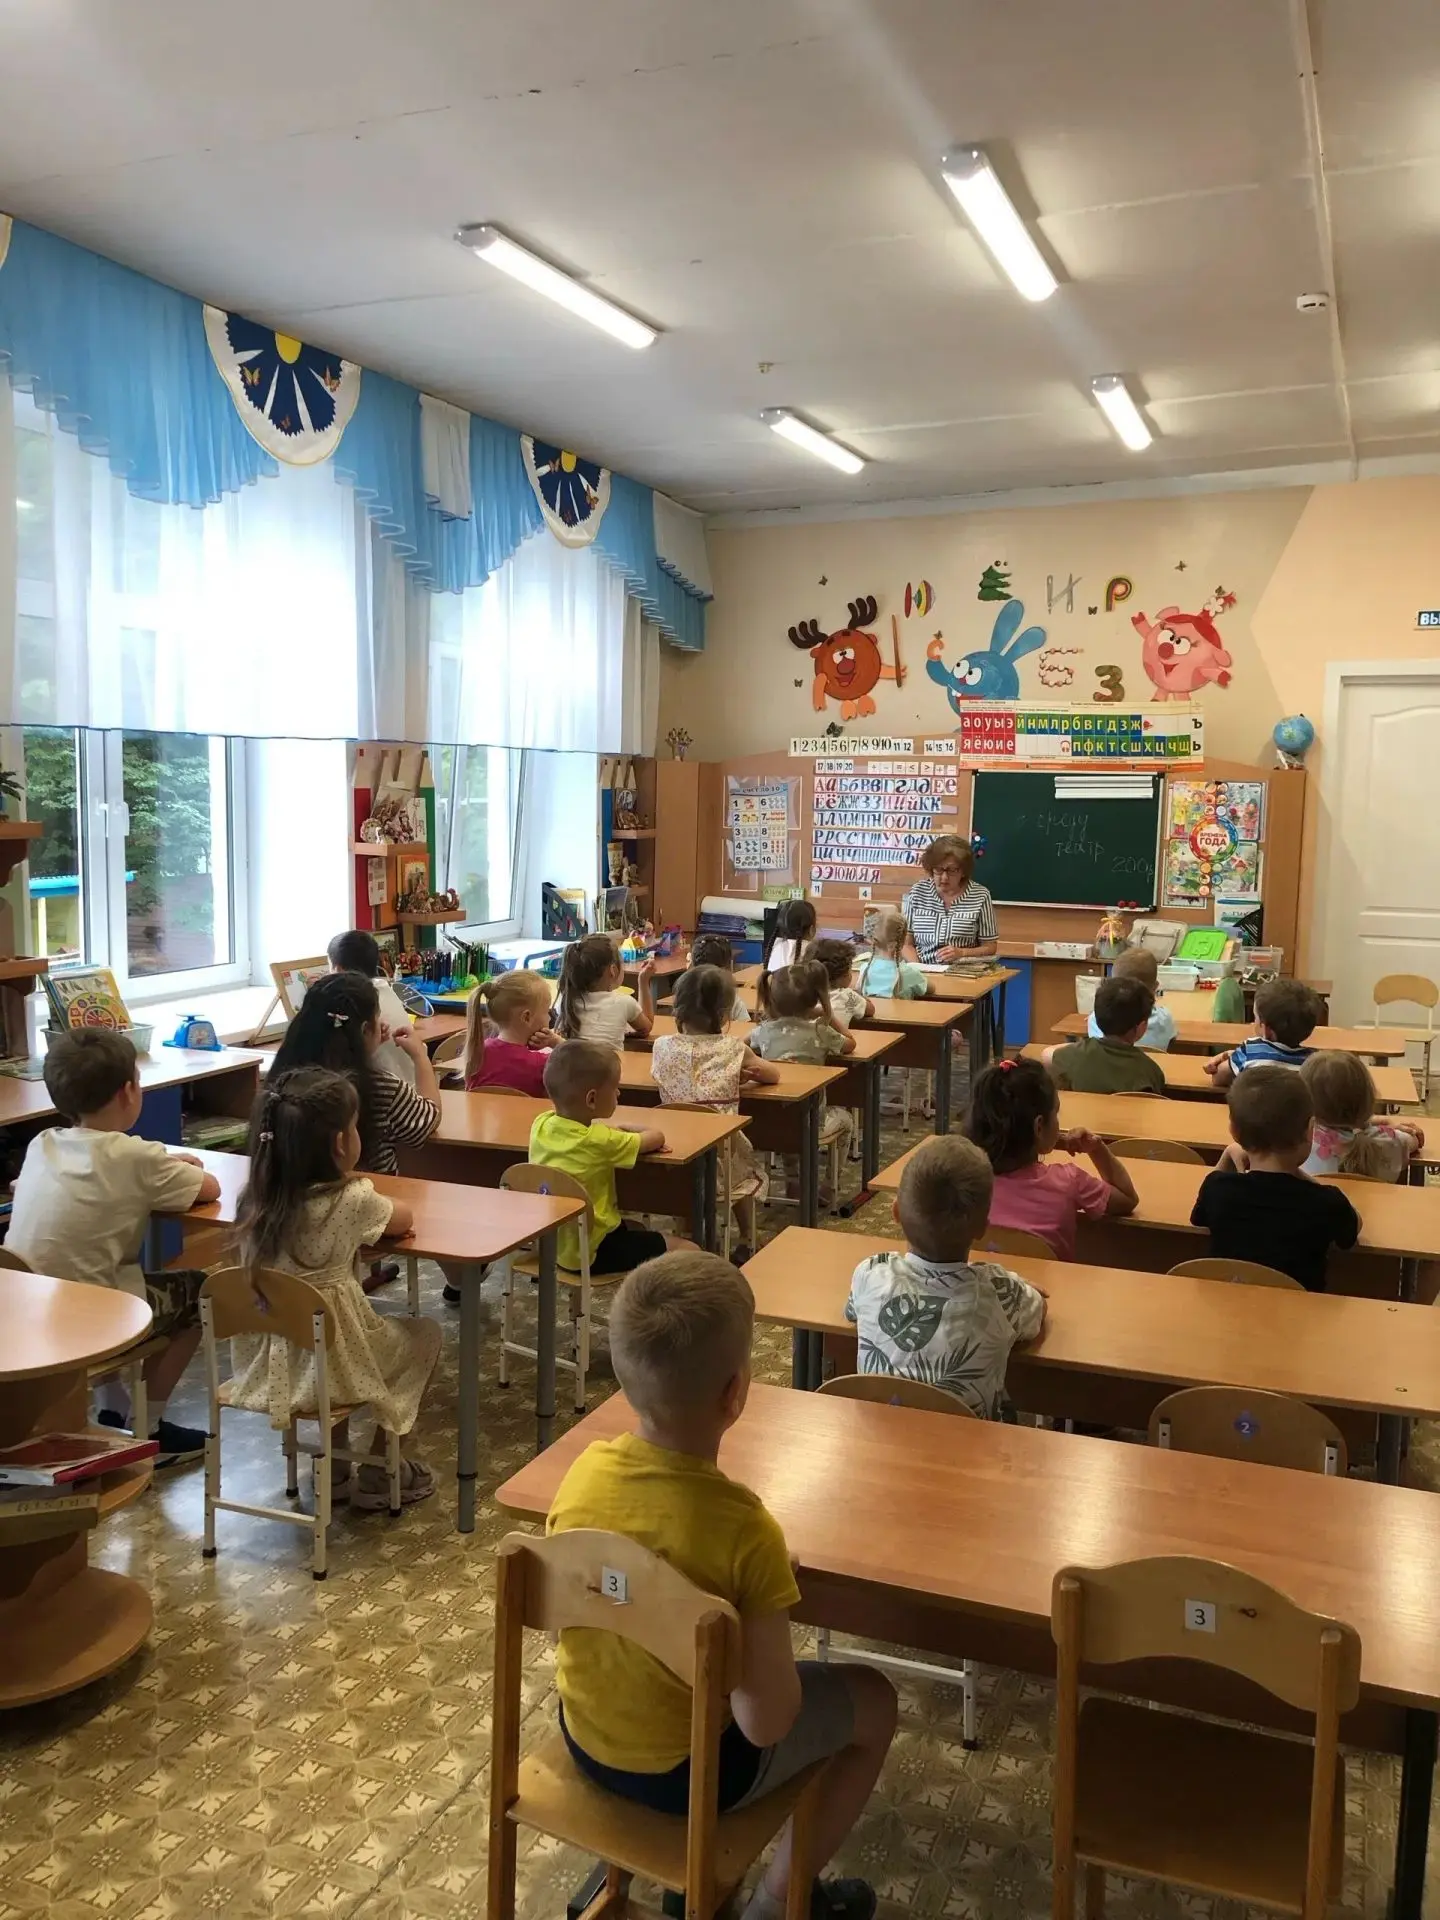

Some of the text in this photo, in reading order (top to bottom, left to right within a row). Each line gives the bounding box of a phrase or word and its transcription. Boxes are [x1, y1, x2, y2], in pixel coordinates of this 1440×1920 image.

[1047, 572, 1082, 614] И
[1104, 576, 1134, 612] Р
[1200, 838, 1226, 846] ГОДА
[1241, 1422, 1250, 1433] 2
[609, 1576, 617, 1592] 3
[1195, 1609, 1205, 1625] 3
